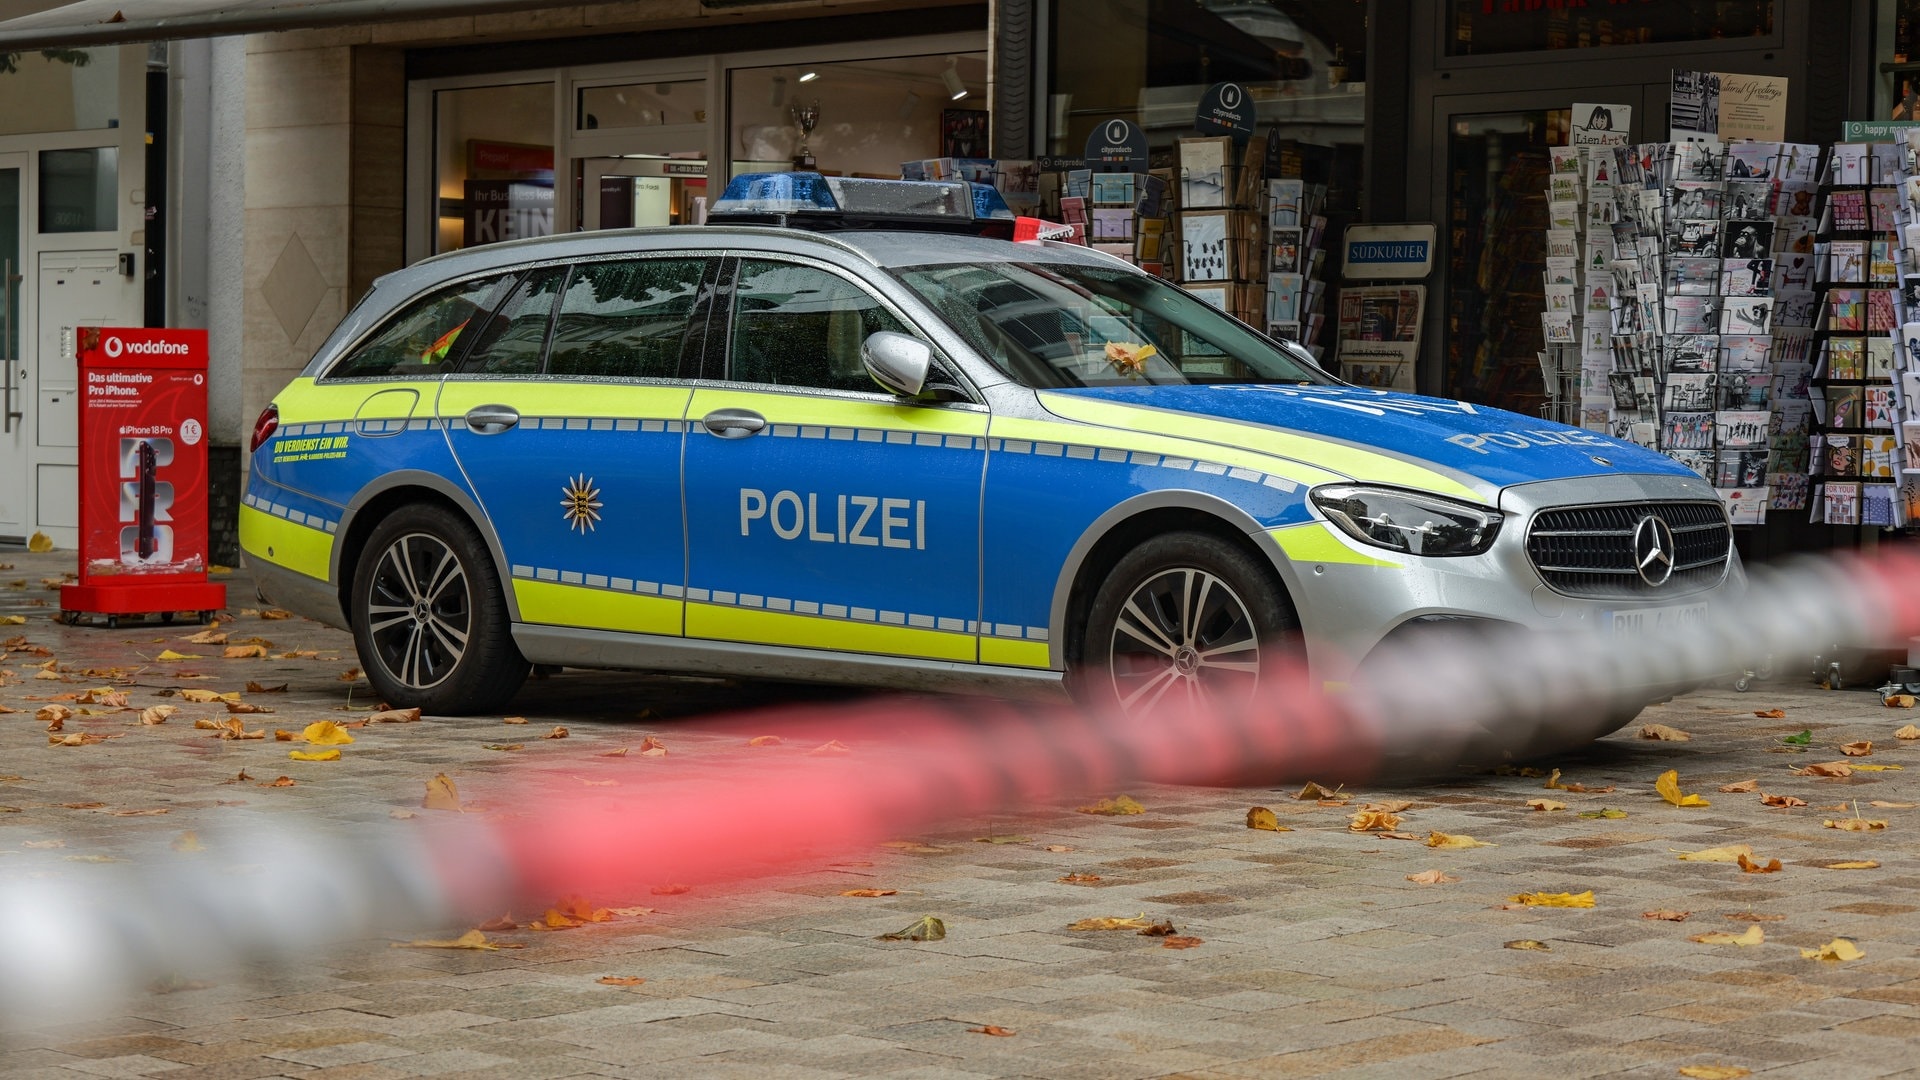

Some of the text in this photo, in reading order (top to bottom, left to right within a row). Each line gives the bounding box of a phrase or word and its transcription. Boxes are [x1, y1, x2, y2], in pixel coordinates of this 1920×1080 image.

[1721, 77, 1747, 95] atural
[1747, 82, 1783, 102] Greetings
[1213, 108, 1241, 121] cityproducts
[1865, 124, 1888, 136] happy
[1101, 146, 1132, 154] cityproducts
[475, 189, 488, 200] Ihr
[490, 189, 535, 201] Business
[474, 207, 554, 243] KEIN
[1352, 245, 1424, 259] SÜDKURIER
[126, 339, 189, 355] vodafone
[88, 372, 153, 383] Das ultimative
[88, 385, 139, 395] Pro iPhone.
[125, 425, 151, 435] iPhone
[160, 425, 173, 435] Pro
[274, 441, 285, 453] DU
[284, 438, 320, 452] VERDIENST
[319, 437, 334, 449] EIN
[1825, 485, 1855, 494] FOR YOUR
[740, 487, 926, 550] POLIZEI
